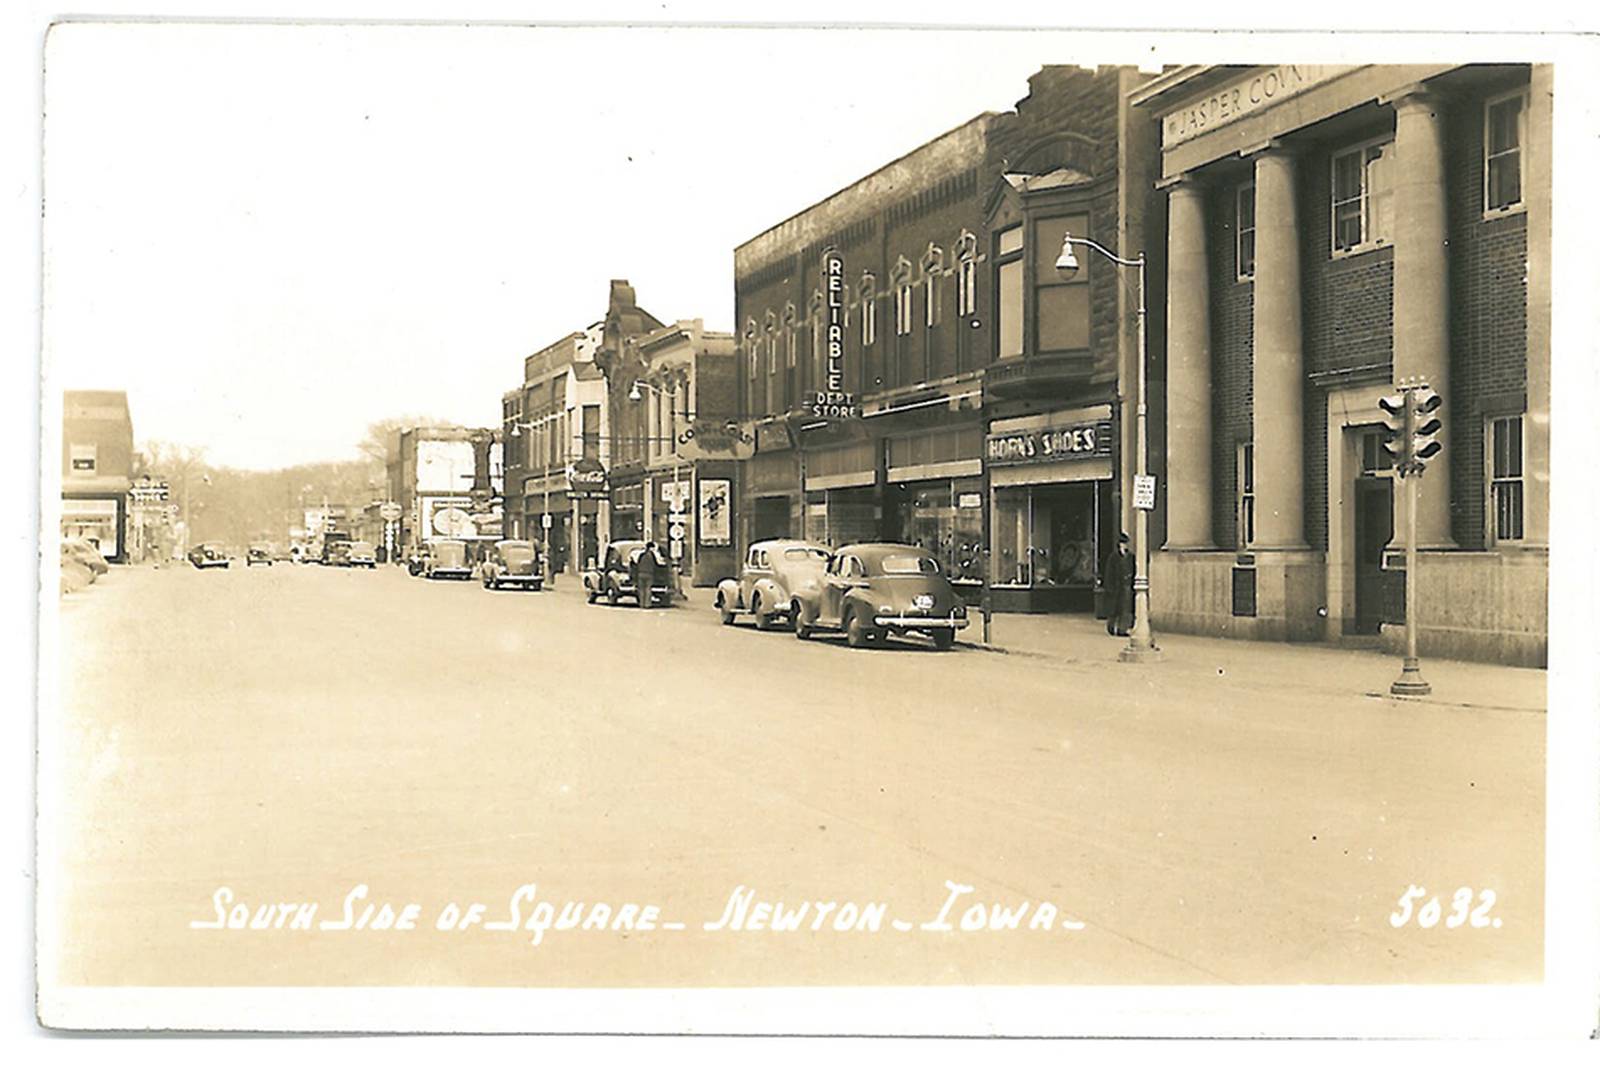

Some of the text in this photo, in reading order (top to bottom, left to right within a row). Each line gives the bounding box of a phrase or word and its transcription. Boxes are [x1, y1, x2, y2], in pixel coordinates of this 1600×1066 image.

[1179, 88, 1241, 135] JASPER
[828, 258, 842, 391] RELIABLE
[813, 405, 857, 417] STORE
[817, 392, 853, 405] DEPT
[1042, 428, 1097, 456] SHOES
